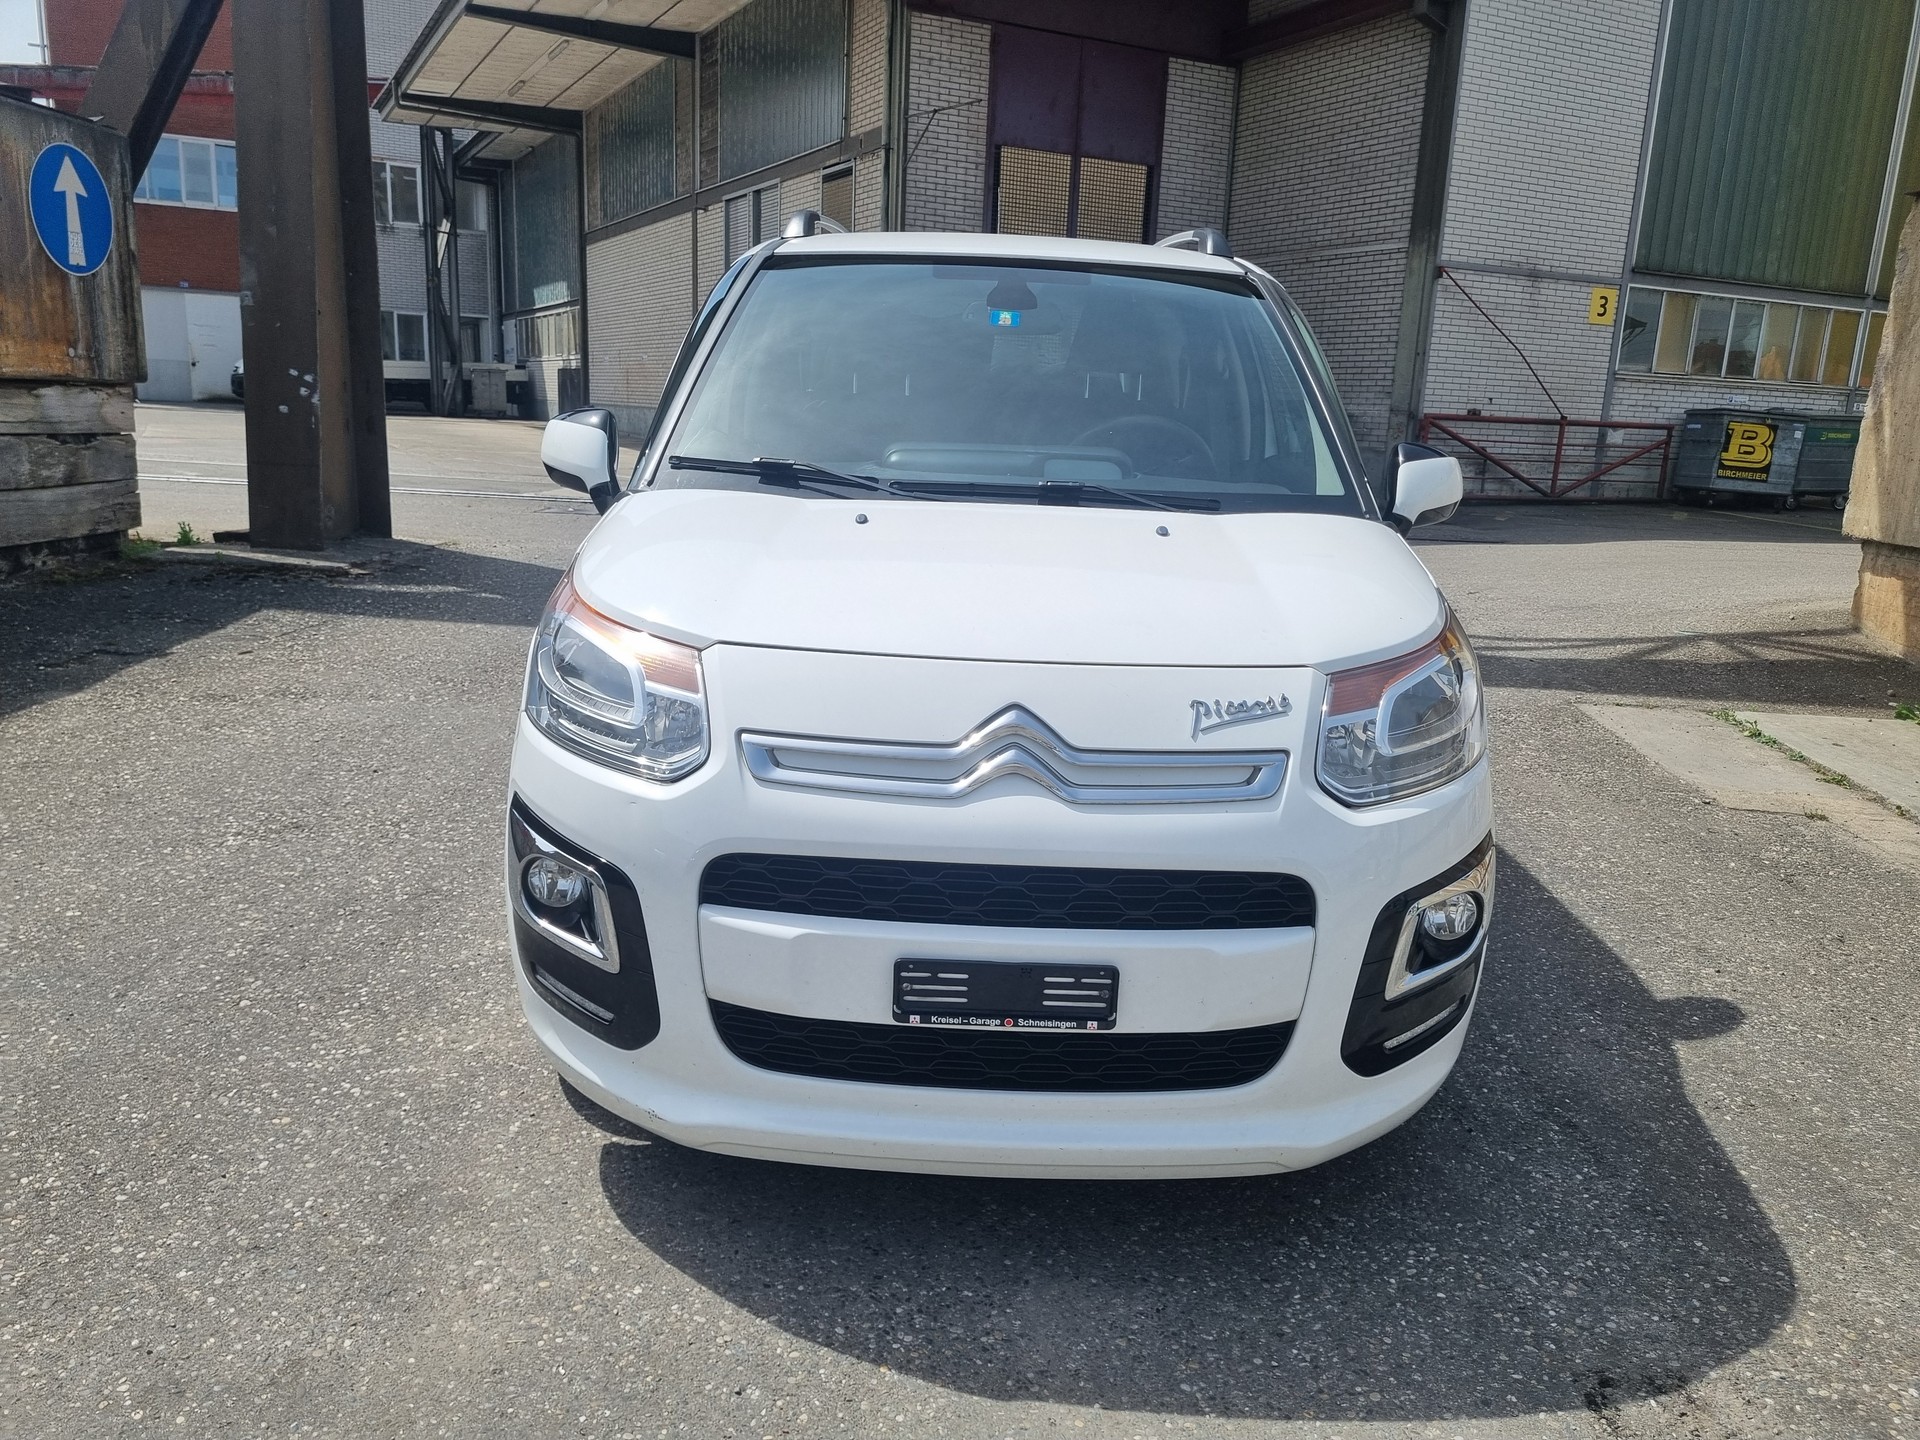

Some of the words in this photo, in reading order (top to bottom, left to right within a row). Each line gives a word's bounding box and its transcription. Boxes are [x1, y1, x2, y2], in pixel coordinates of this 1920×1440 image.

[1597, 296, 1609, 317] 3
[1720, 422, 1774, 468] B
[1717, 469, 1768, 480] BIRCHMEIER
[1017, 1018, 1077, 1029] Schneisingen
